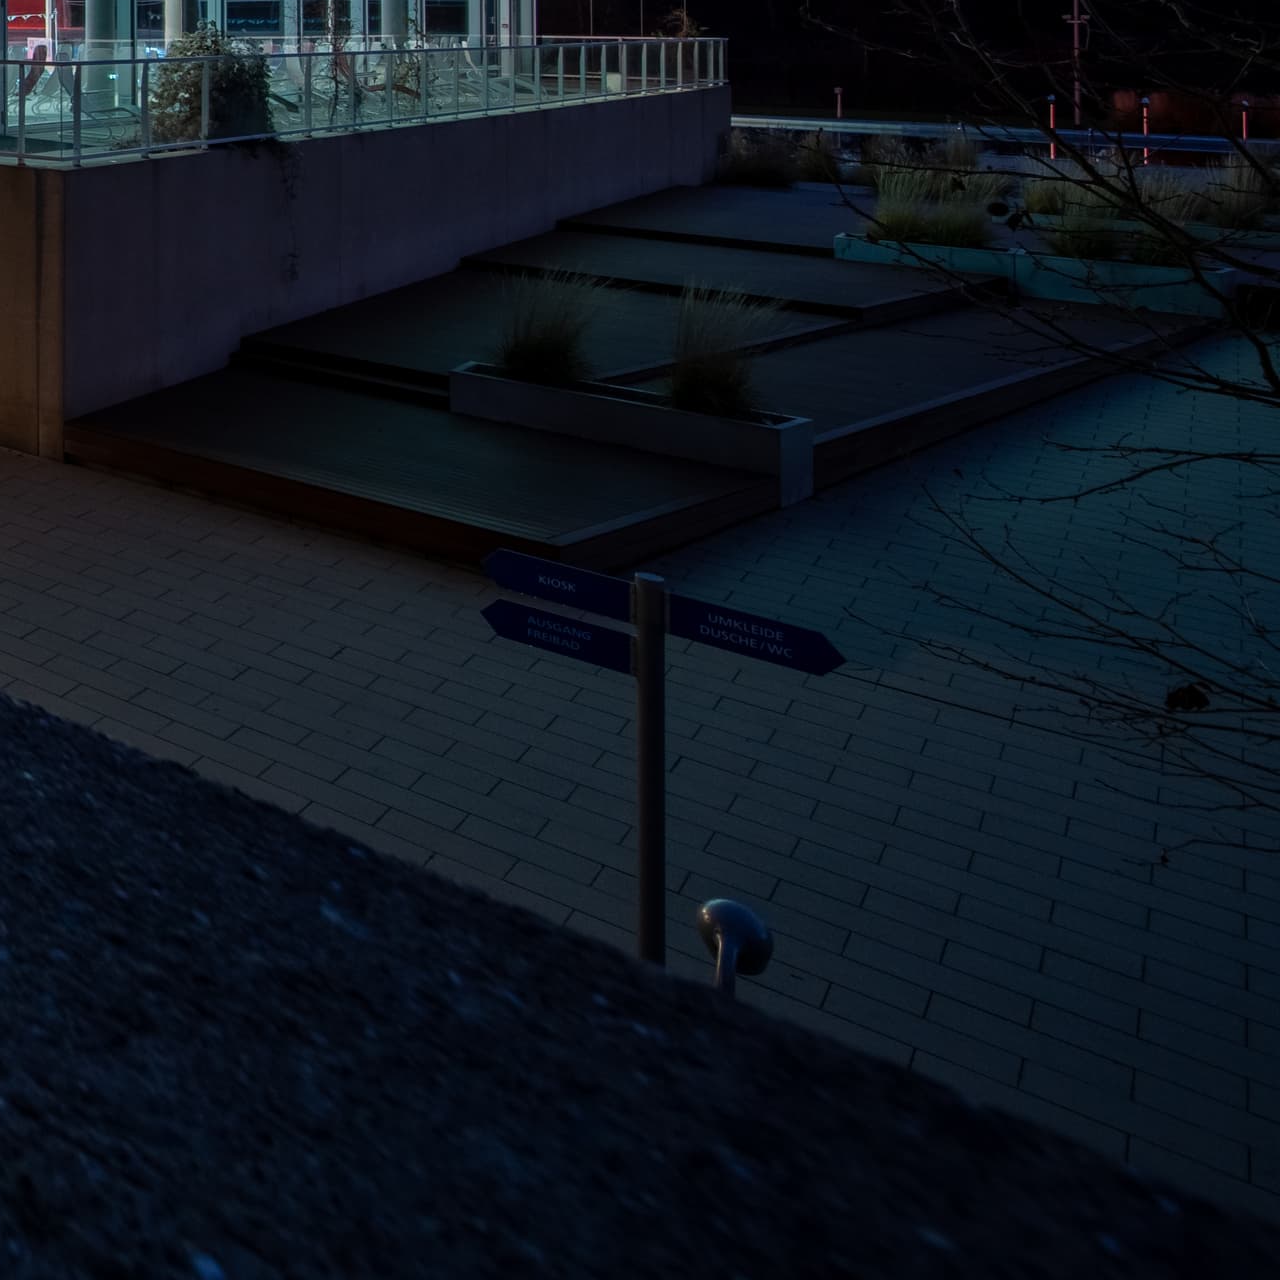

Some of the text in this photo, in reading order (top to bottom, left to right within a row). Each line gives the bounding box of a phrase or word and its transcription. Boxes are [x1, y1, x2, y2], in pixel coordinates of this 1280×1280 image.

[537, 575, 576, 593] KIOSK
[528, 615, 592, 640] AUSGANG
[708, 612, 785, 641] UMKLEIDE
[528, 627, 580, 651] FREIBAD
